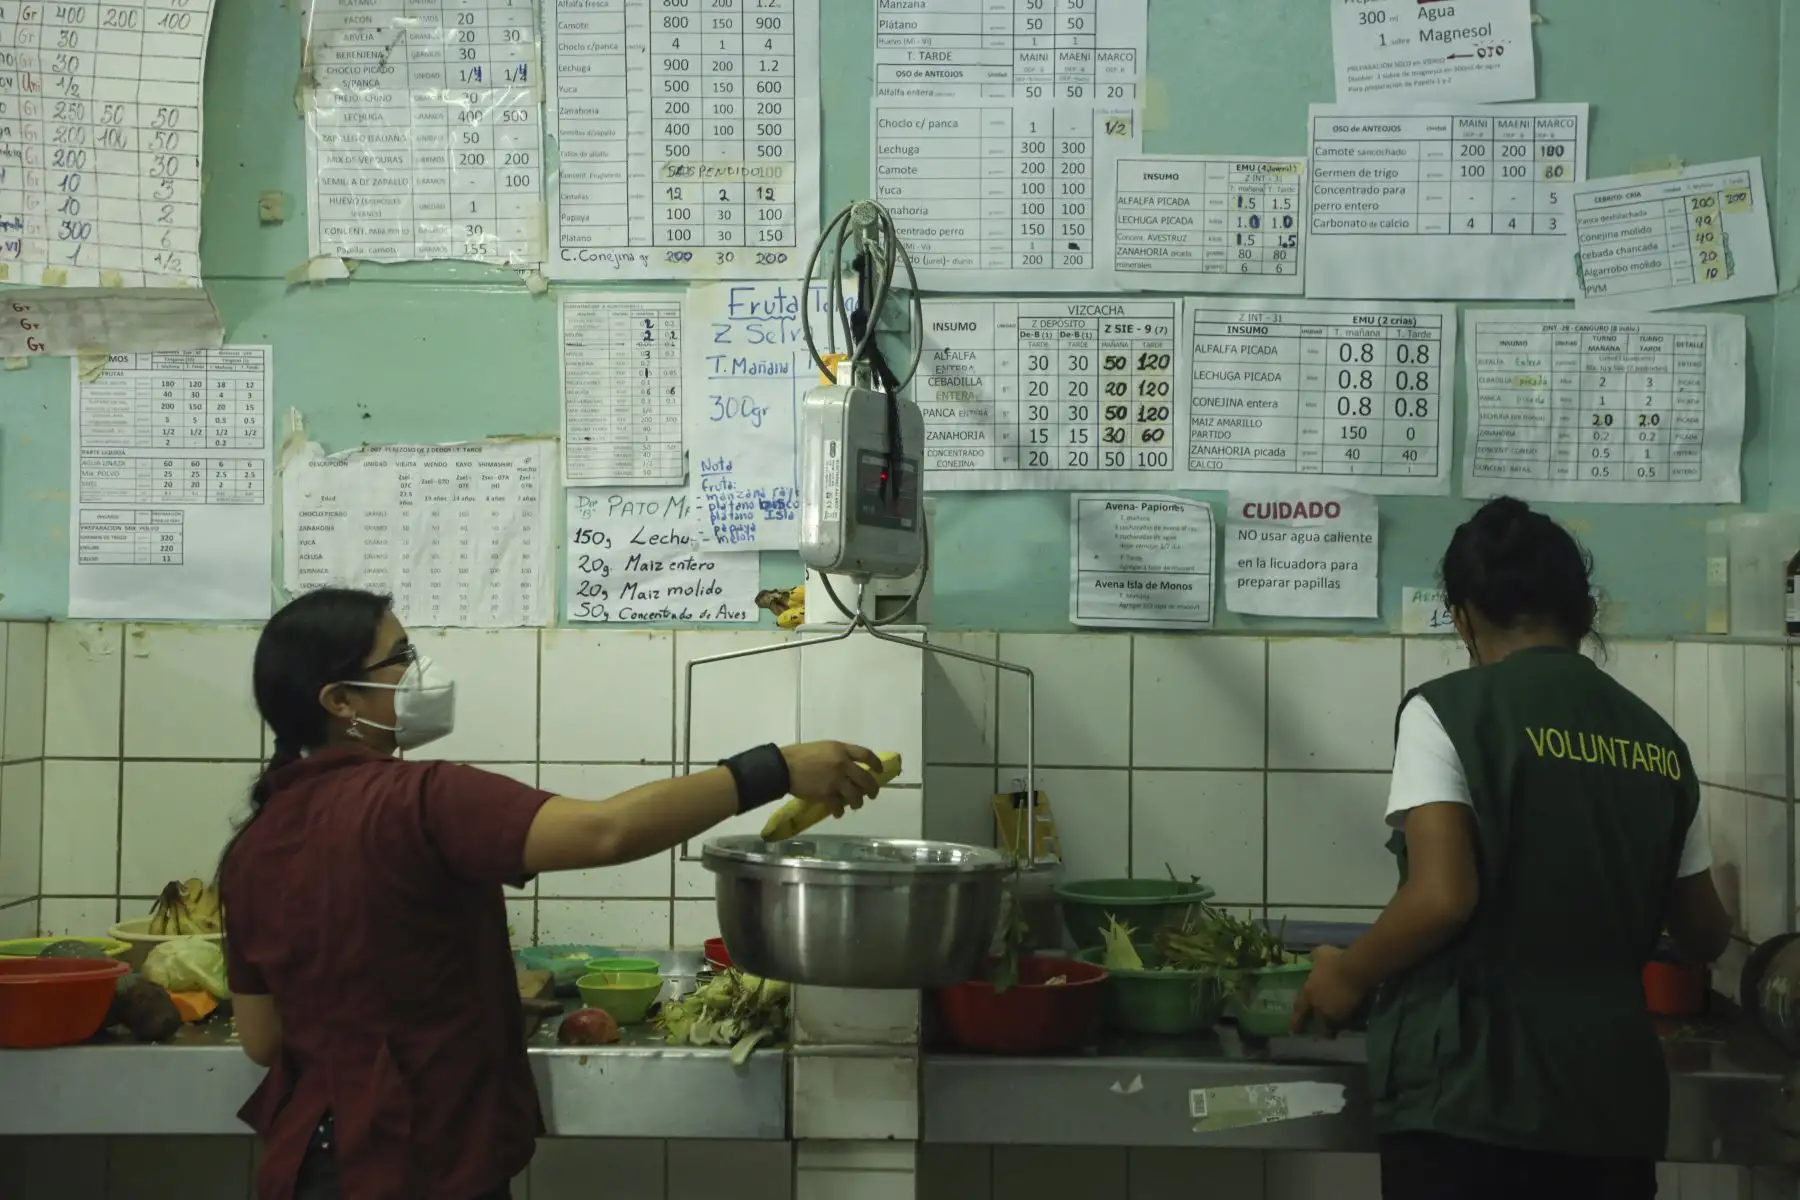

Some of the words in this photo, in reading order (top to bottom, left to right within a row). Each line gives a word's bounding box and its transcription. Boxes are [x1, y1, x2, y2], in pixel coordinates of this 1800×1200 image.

[56, 6, 85, 24] 400
[157, 13, 191, 29] 100
[458, 13, 474, 24] 20
[1359, 10, 1385, 25] 300
[1417, 6, 1455, 20] Agua
[663, 17, 689, 29] 800
[756, 18, 781, 29] 900
[879, 19, 918, 29] Plátano
[1026, 19, 1042, 30] 50
[1068, 18, 1084, 29] 50
[57, 30, 78, 48] 30
[459, 31, 475, 42] 20
[503, 30, 520, 41] 30
[1420, 23, 1492, 44] Magnesol
[908, 52, 917, 61] T.
[920, 52, 952, 61] TARDE
[1059, 53, 1091, 61] MAENI
[1098, 53, 1134, 62] MARCO
[558, 64, 591, 73] Lechuga
[664, 59, 689, 71] 900
[664, 81, 689, 92] 500
[756, 81, 781, 93] 600
[151, 109, 179, 128] 50
[879, 118, 913, 128] Choclo
[928, 119, 958, 129] panca
[1537, 119, 1574, 128] MARCO
[463, 132, 479, 143] 50
[879, 144, 920, 155] Lechuga
[1020, 142, 1045, 153] 300
[1061, 142, 1085, 154] 300
[1460, 145, 1485, 157] 200
[1502, 145, 1526, 157] 200
[52, 150, 86, 168] 200
[150, 156, 179, 177] 30
[459, 154, 484, 165] 200
[505, 153, 529, 165] 200
[878, 165, 918, 175] Camote
[1143, 173, 1179, 181] INSUMO
[1236, 164, 1255, 172] EMU
[1315, 168, 1356, 178] Germen
[1359, 168, 1371, 178] de
[1374, 168, 1398, 180] trigo
[1461, 165, 1485, 177] 100
[58, 174, 81, 192] 10
[505, 175, 529, 186] 100
[879, 185, 902, 195] Yuca
[1022, 183, 1045, 194] 100
[1315, 185, 1380, 195] Concentrado
[1382, 187, 1405, 197] para
[1118, 197, 1155, 205] ALFALFA
[1157, 198, 1190, 206] PICADA
[1314, 202, 1341, 212] perro
[1344, 202, 1379, 211] entero
[666, 208, 690, 220] 100
[758, 209, 782, 220] 100
[1118, 216, 1158, 225] LECHUGA
[1161, 217, 1193, 225] PICADA
[1314, 218, 1367, 229] Carbonato
[1380, 218, 1409, 229] calcio
[939, 227, 964, 237] perro
[1021, 224, 1045, 235] 150
[1580, 228, 1619, 243] Conejina
[1621, 225, 1652, 237] molido
[1117, 248, 1168, 257] ZANAHORIA
[1582, 249, 1614, 261] cebada
[1616, 242, 1658, 255] chancada
[1699, 251, 1717, 264] 20
[1116, 261, 1152, 269] minerales
[1584, 263, 1628, 278] Algarrobo
[1631, 259, 1662, 270] molido
[1706, 268, 1718, 279] 10
[728, 287, 798, 317] Fruta
[1068, 306, 1124, 315] VIZCACHA
[1352, 315, 1374, 325] EMU
[712, 323, 732, 344] Z
[932, 322, 977, 332] INSUMO
[1105, 325, 1111, 333] Z
[1115, 325, 1133, 334] SIE
[1227, 326, 1268, 335] INSUMO
[1195, 345, 1236, 355] ALFALFA
[1240, 346, 1278, 356] PICADA
[1339, 343, 1373, 363] 0.8
[1397, 344, 1429, 364] 0.8
[1028, 355, 1049, 371] 30
[1068, 355, 1089, 371] 30
[1194, 371, 1240, 381] LECHUGA
[1244, 372, 1282, 382] PICADA
[1338, 370, 1373, 389] 0.8
[1600, 377, 1606, 388] 2
[1646, 377, 1652, 388] 3
[928, 377, 982, 386] CEBADILLA
[1029, 381, 1049, 396] 20
[1192, 397, 1243, 408] CONEJINA
[1247, 399, 1278, 409] entera
[1394, 398, 1428, 417] 0.8
[1192, 418, 1214, 427] MAIZ
[1217, 419, 1262, 428] AMARILLO
[162, 428, 175, 436] 1/2
[927, 431, 985, 441] ZANAHORIA
[1030, 428, 1049, 444] 15
[1191, 430, 1231, 440] PARTIDO
[1341, 426, 1367, 440] 150
[1592, 431, 1610, 442] 0.2
[1639, 432, 1655, 442] 0.2
[1191, 445, 1250, 456] ZANAHORIA
[1254, 448, 1285, 458] picada
[1592, 448, 1610, 458] 0.5
[164, 460, 173, 468] 60
[1105, 451, 1125, 467] 50
[1138, 451, 1168, 467] 100
[1242, 501, 1341, 520] CUIDADO
[160, 534, 173, 542] 320
[1238, 529, 1258, 541] NO
[1261, 532, 1287, 542] usar
[1291, 532, 1320, 545] agua
[1324, 531, 1372, 544] caliente
[670, 556, 715, 571] entero
[1238, 559, 1252, 569] en
[1256, 558, 1267, 569] la
[1270, 557, 1327, 571] licuadora
[1331, 560, 1358, 573] para
[668, 578, 722, 597] molido
[1095, 579, 1124, 589] Avena
[1127, 579, 1143, 589] Isla
[1146, 581, 1158, 590] de
[1160, 582, 1192, 592] Monos
[1238, 576, 1291, 590] preparar
[1294, 576, 1341, 591] papillas
[716, 604, 746, 620] Aves
[1526, 727, 1681, 780] VOLUNTARIO
